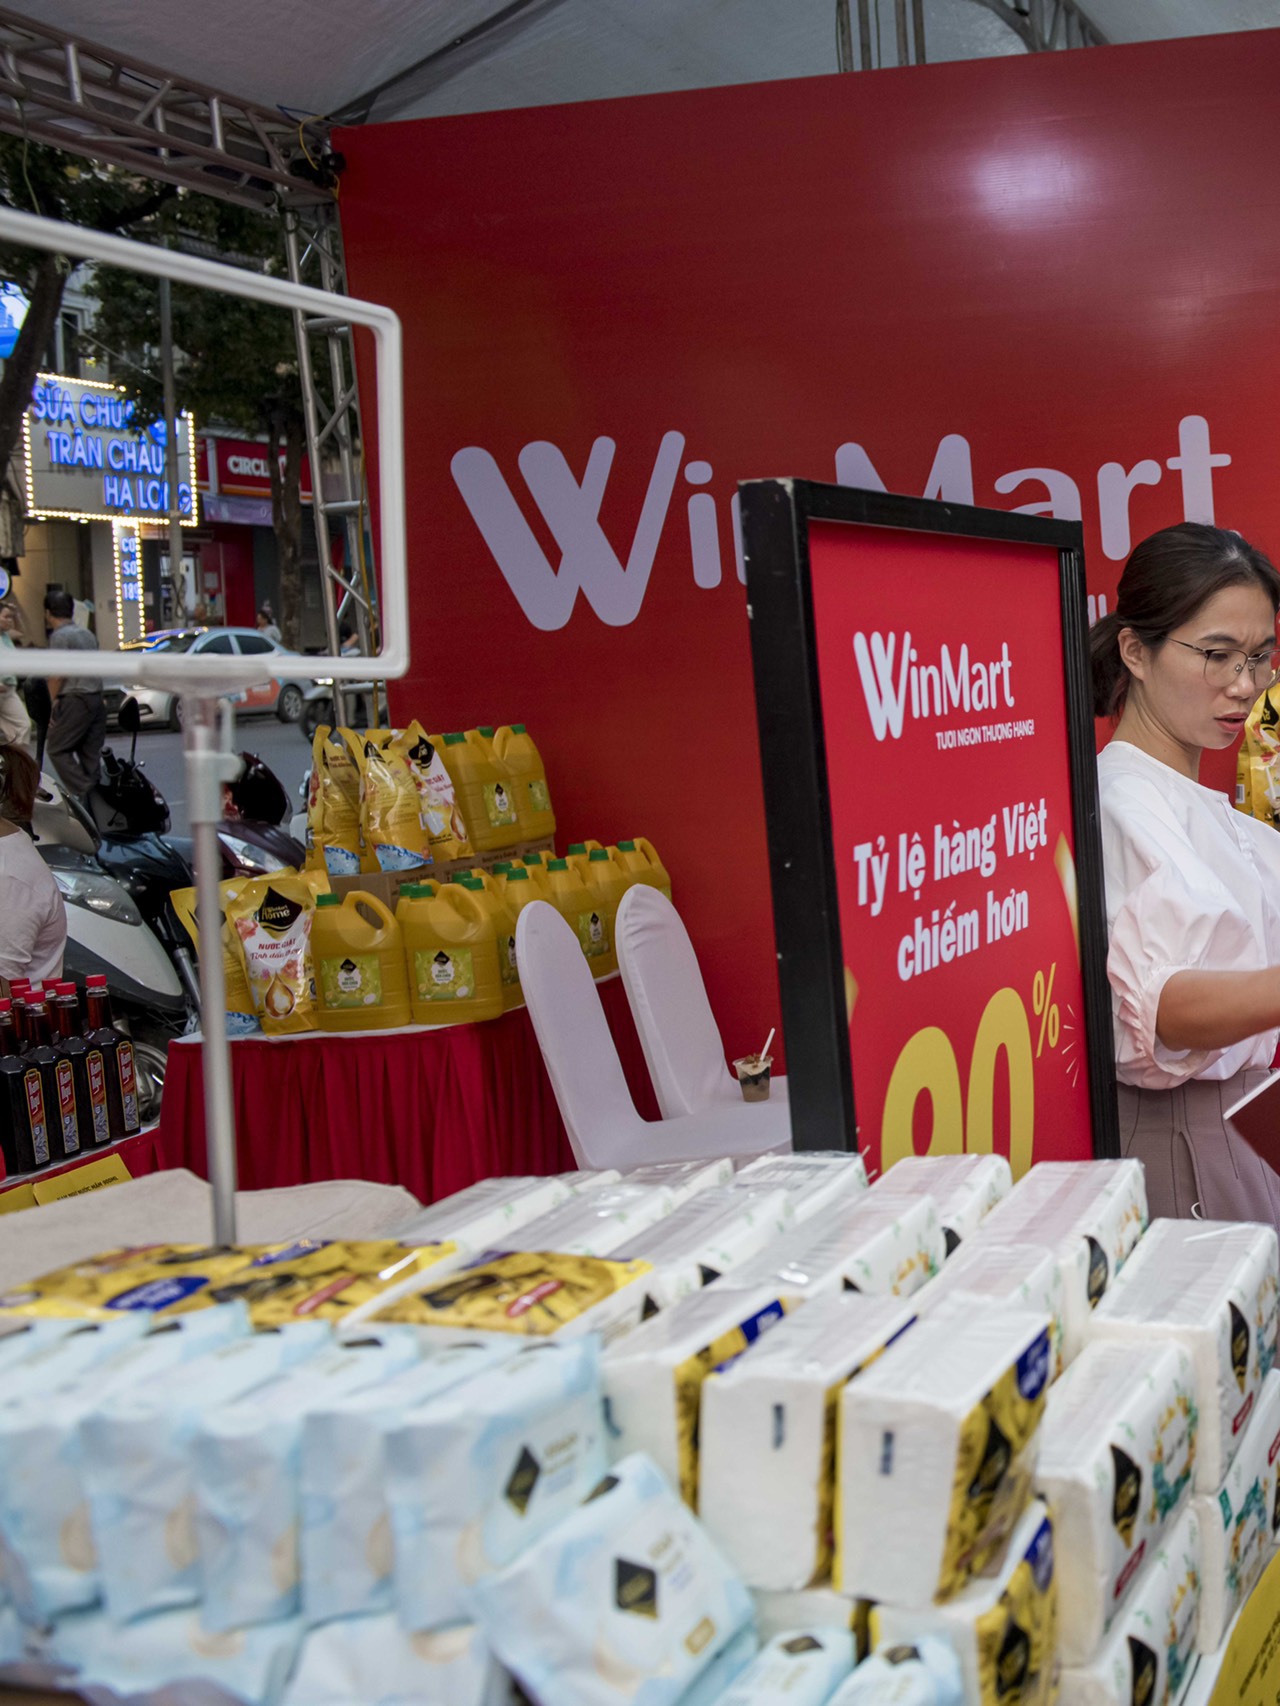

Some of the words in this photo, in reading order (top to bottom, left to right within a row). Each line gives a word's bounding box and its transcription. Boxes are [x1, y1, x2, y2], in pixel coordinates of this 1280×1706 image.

[48, 427, 103, 469] TRÂN
[107, 435, 164, 476] CHÂU
[227, 455, 271, 478] CIRCL
[104, 474, 134, 514] HẠ
[853, 631, 1015, 741] WinMart
[853, 835, 889, 917] Tỷ
[898, 832, 926, 901] lệ
[934, 815, 997, 878] hàng
[1002, 798, 1047, 861] Việt
[261, 907, 291, 921] Home
[897, 900, 979, 982] chiếm
[987, 889, 1029, 944] hơn
